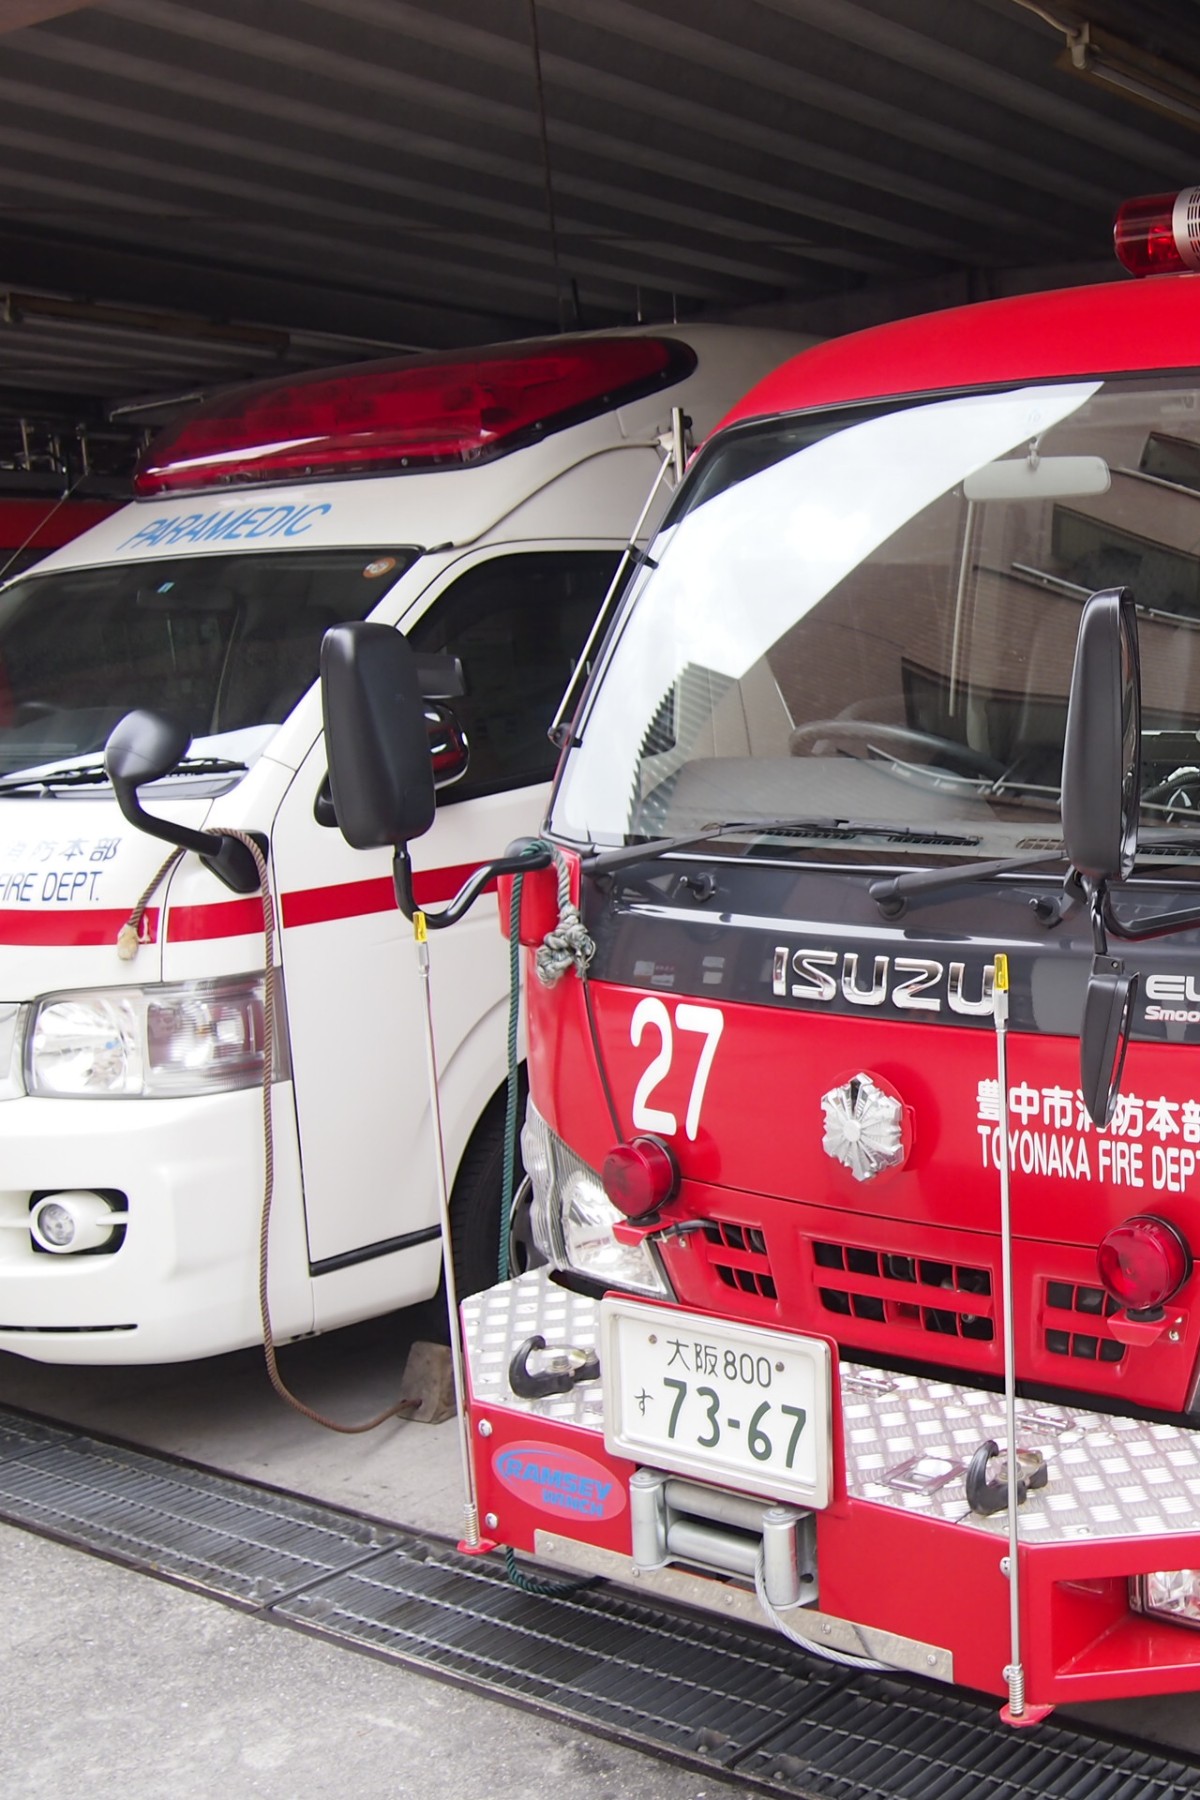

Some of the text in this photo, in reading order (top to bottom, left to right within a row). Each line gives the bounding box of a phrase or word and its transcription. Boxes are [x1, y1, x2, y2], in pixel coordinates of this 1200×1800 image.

[115, 503, 332, 551] PARAMEDIC
[41, 871, 103, 902] DEPT.
[772, 946, 996, 1016] ISUZU
[630, 996, 724, 1141] 27
[1099, 1139, 1144, 1187] FIRE
[666, 1339, 772, 1388] 大阪800
[634, 1376, 807, 1468] す 73-67
[505, 1459, 612, 1500] RAMSEY
[542, 1488, 605, 1517] WINCH
